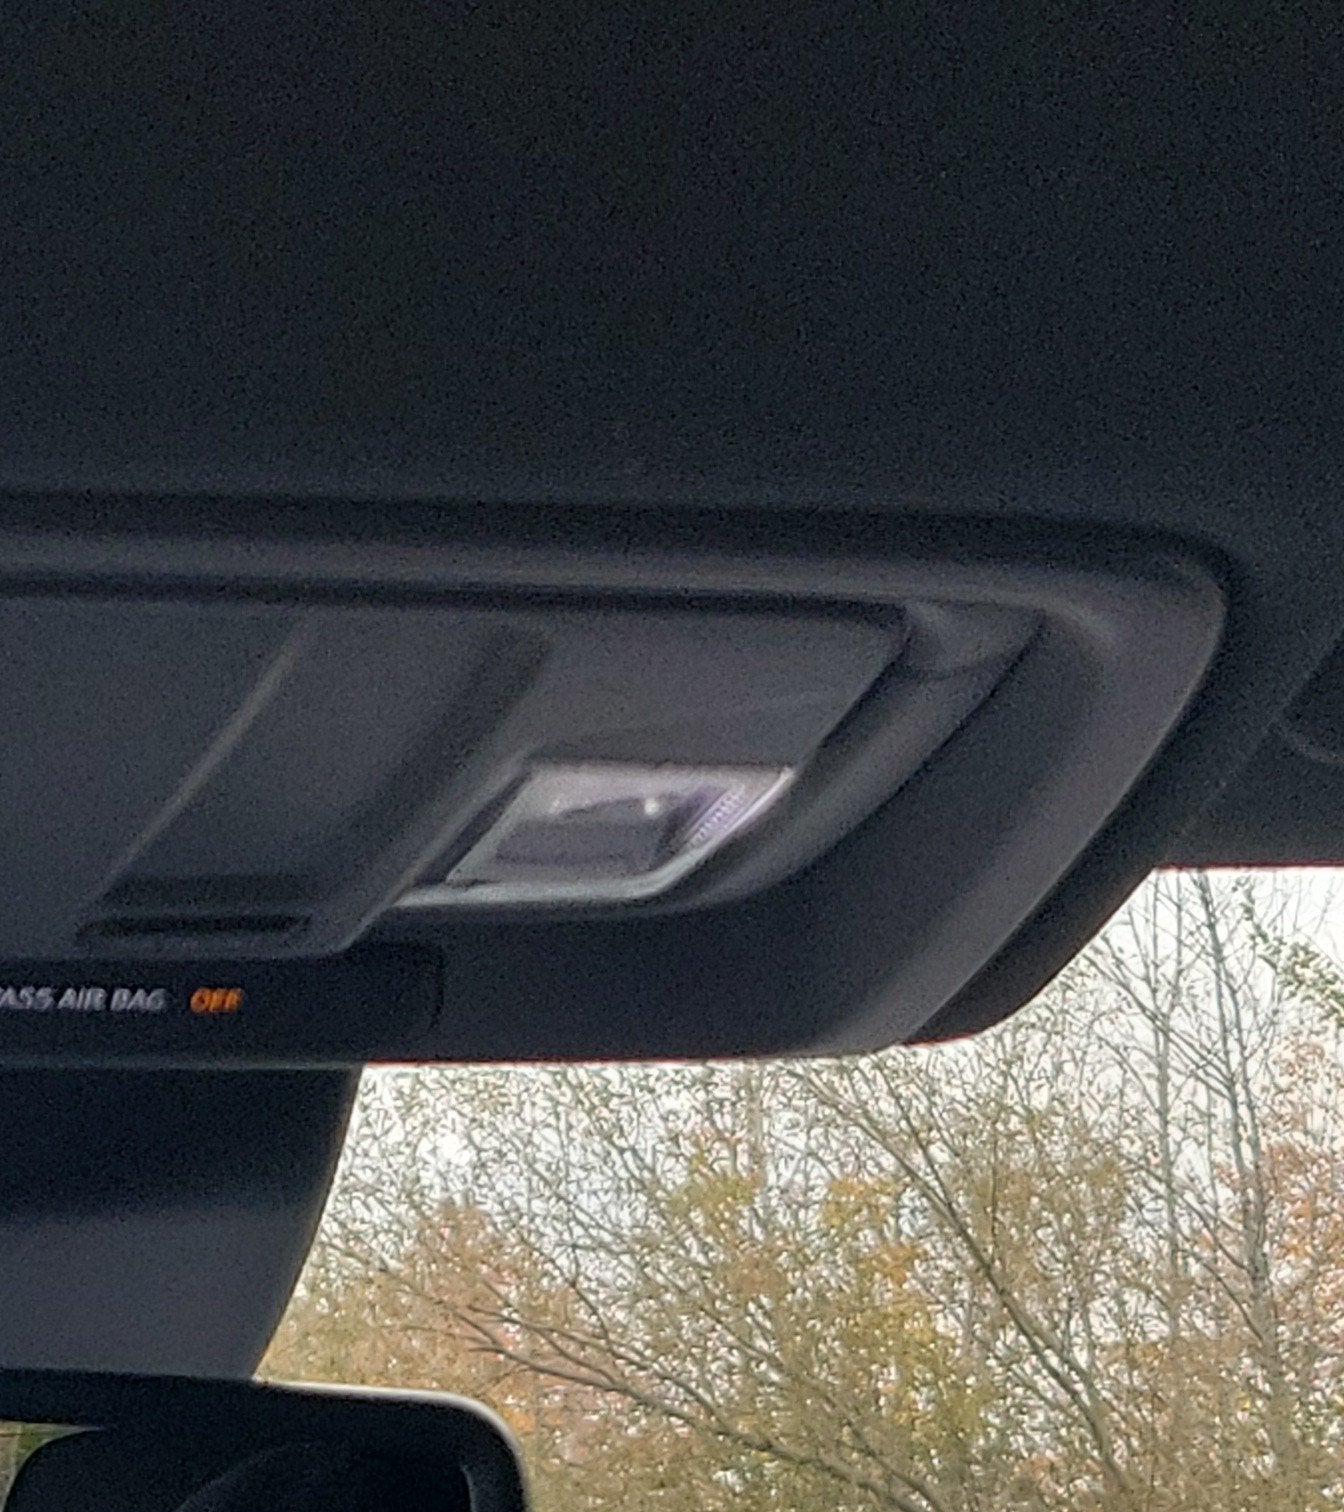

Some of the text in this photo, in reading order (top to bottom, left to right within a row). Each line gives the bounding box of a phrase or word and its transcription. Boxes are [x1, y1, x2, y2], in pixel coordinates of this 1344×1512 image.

[57, 987, 107, 1010] AIR
[110, 987, 167, 1011] BAG
[189, 986, 244, 1012] OFF
